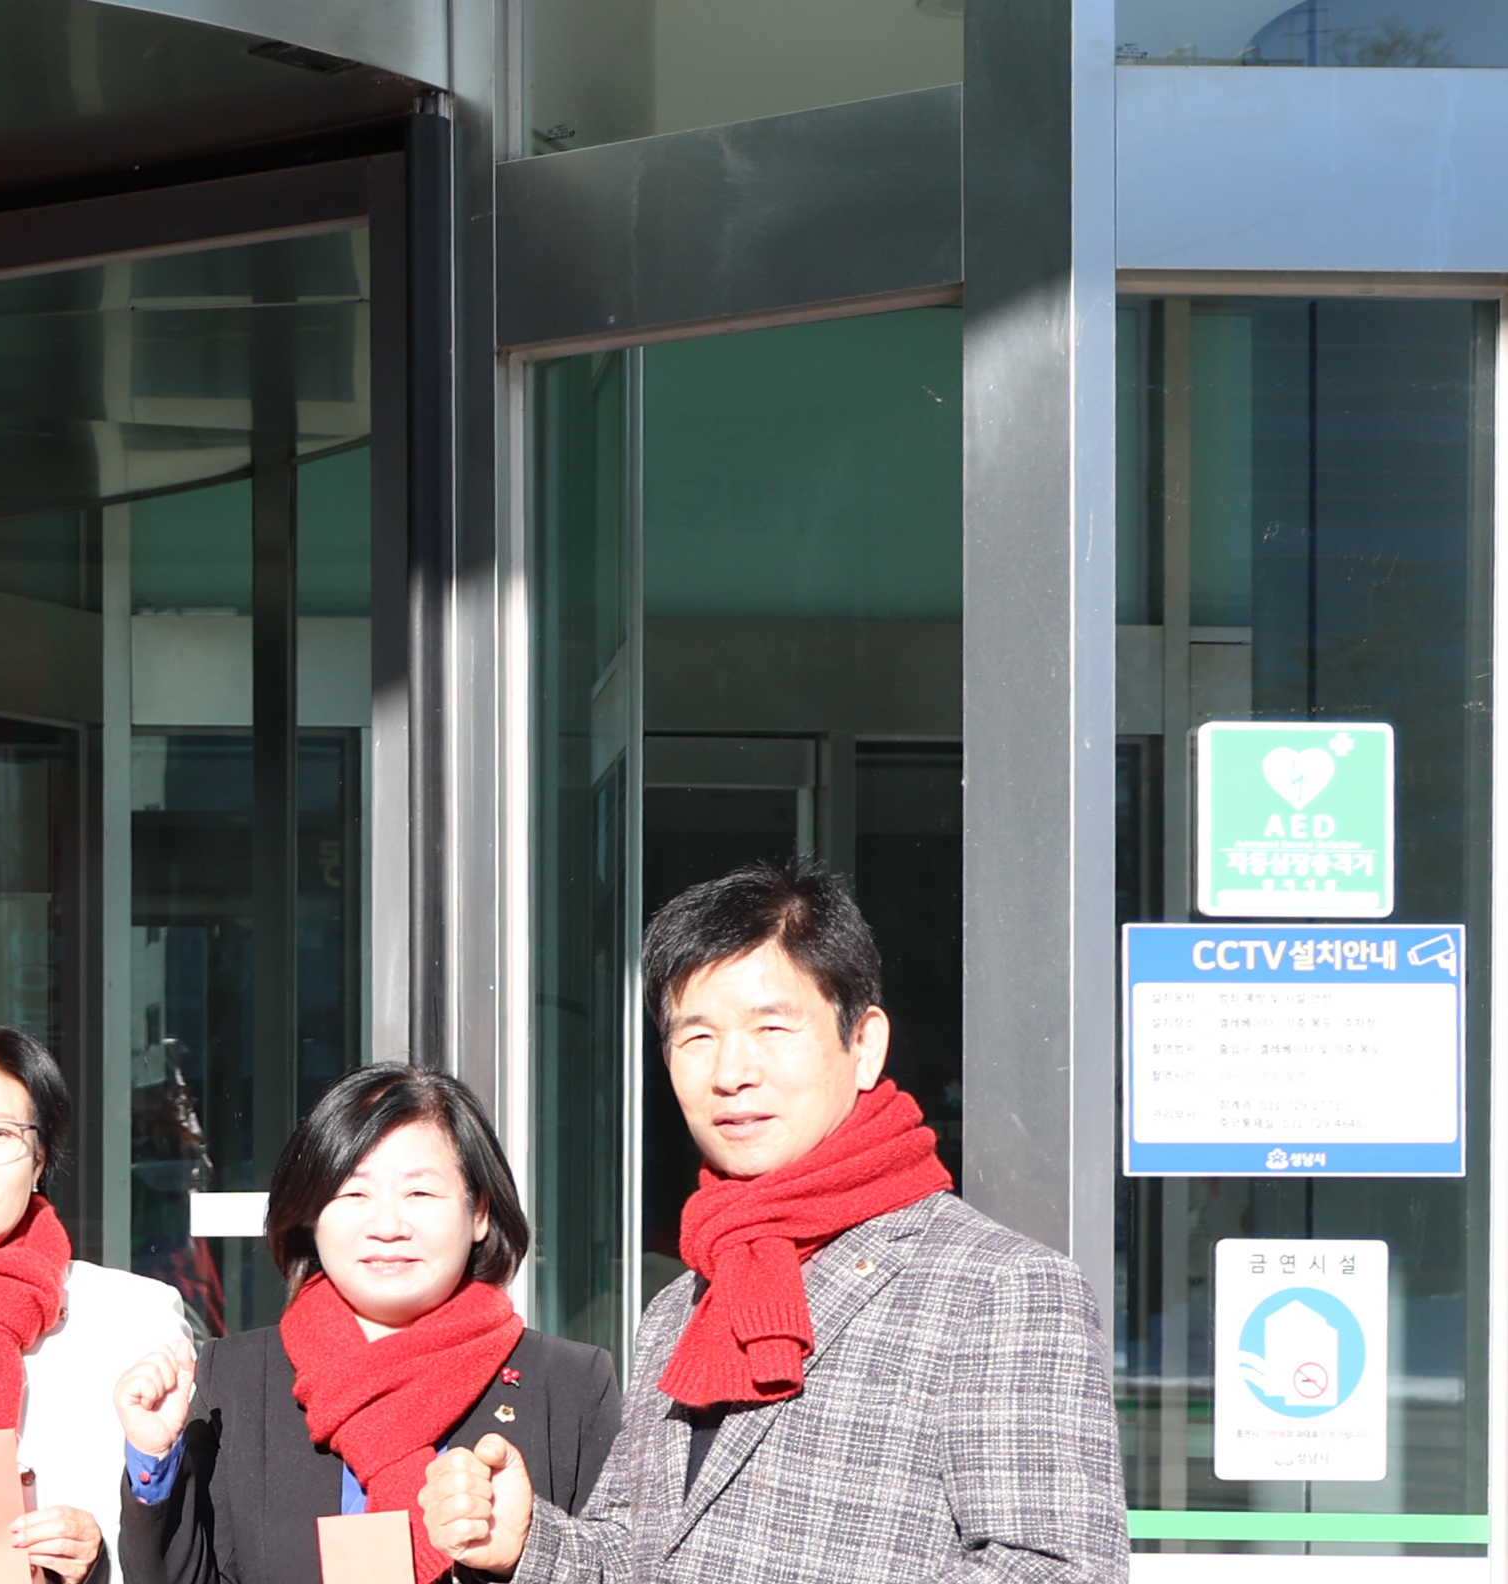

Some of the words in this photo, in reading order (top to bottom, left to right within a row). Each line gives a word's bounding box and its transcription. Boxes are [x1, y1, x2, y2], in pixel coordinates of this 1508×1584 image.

[1264, 814, 1335, 839] AED
[1226, 853, 1374, 876] 자동심장충격기
[1192, 940, 1396, 971] CCTV설치안내
[1290, 1152, 1326, 1167] 성남시
[1249, 1254, 1356, 1275] 금연시설
[1298, 1454, 1327, 1464] 성남시
